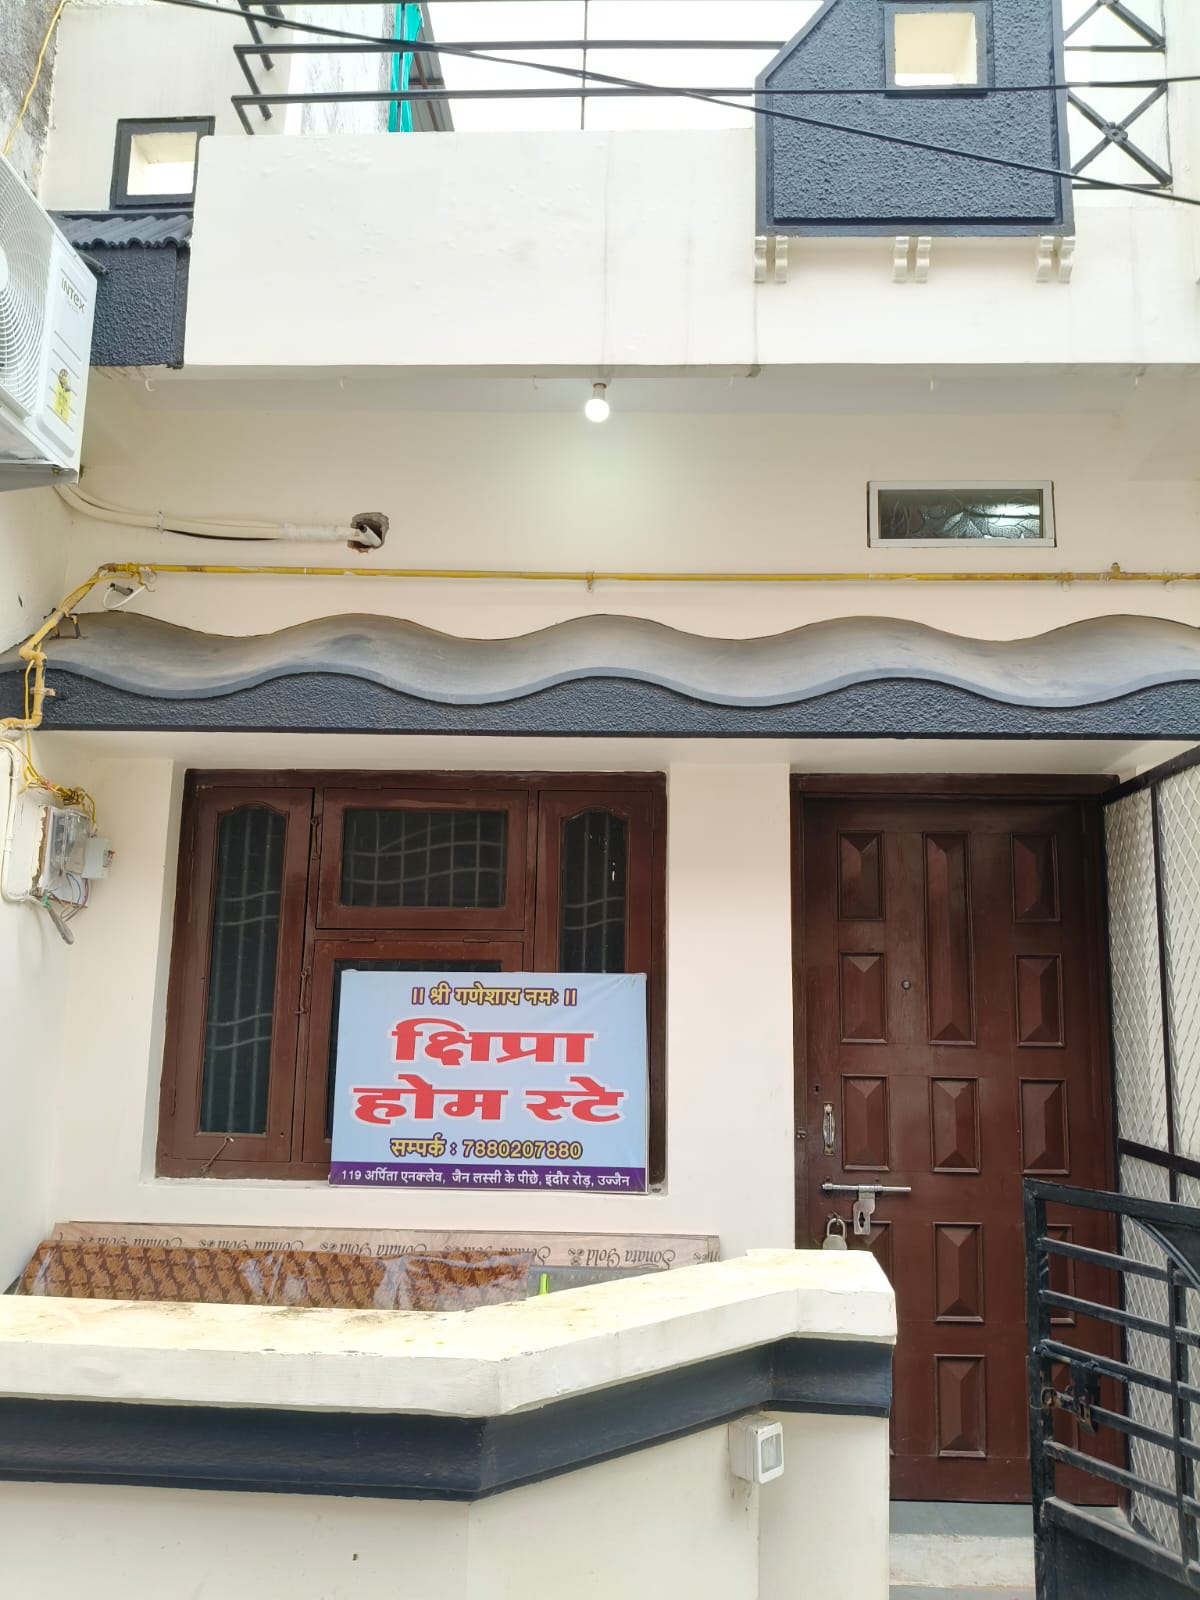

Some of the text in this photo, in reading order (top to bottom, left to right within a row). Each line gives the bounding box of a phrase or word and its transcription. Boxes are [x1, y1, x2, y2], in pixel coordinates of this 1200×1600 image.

[430, 982, 450, 1005] श्री
[455, 982, 520, 1005] गणेशाय
[392, 1018, 594, 1066] क्षिप्रा
[353, 1074, 624, 1124] होम स्टे
[390, 1132, 445, 1157] सम्पर्क
[463, 1140, 582, 1159] 7880207880
[341, 1169, 361, 1182] 119
[365, 1168, 398, 1184] अर्पिता
[452, 1169, 472, 1183] जैन
[474, 1169, 502, 1184] लस्सी
[504, 1169, 515, 1184] के
[545, 1170, 570, 1187] इंदौर
[597, 1171, 630, 1187] उज्जैन
[585, 1248, 676, 1270] Sonata Gold
